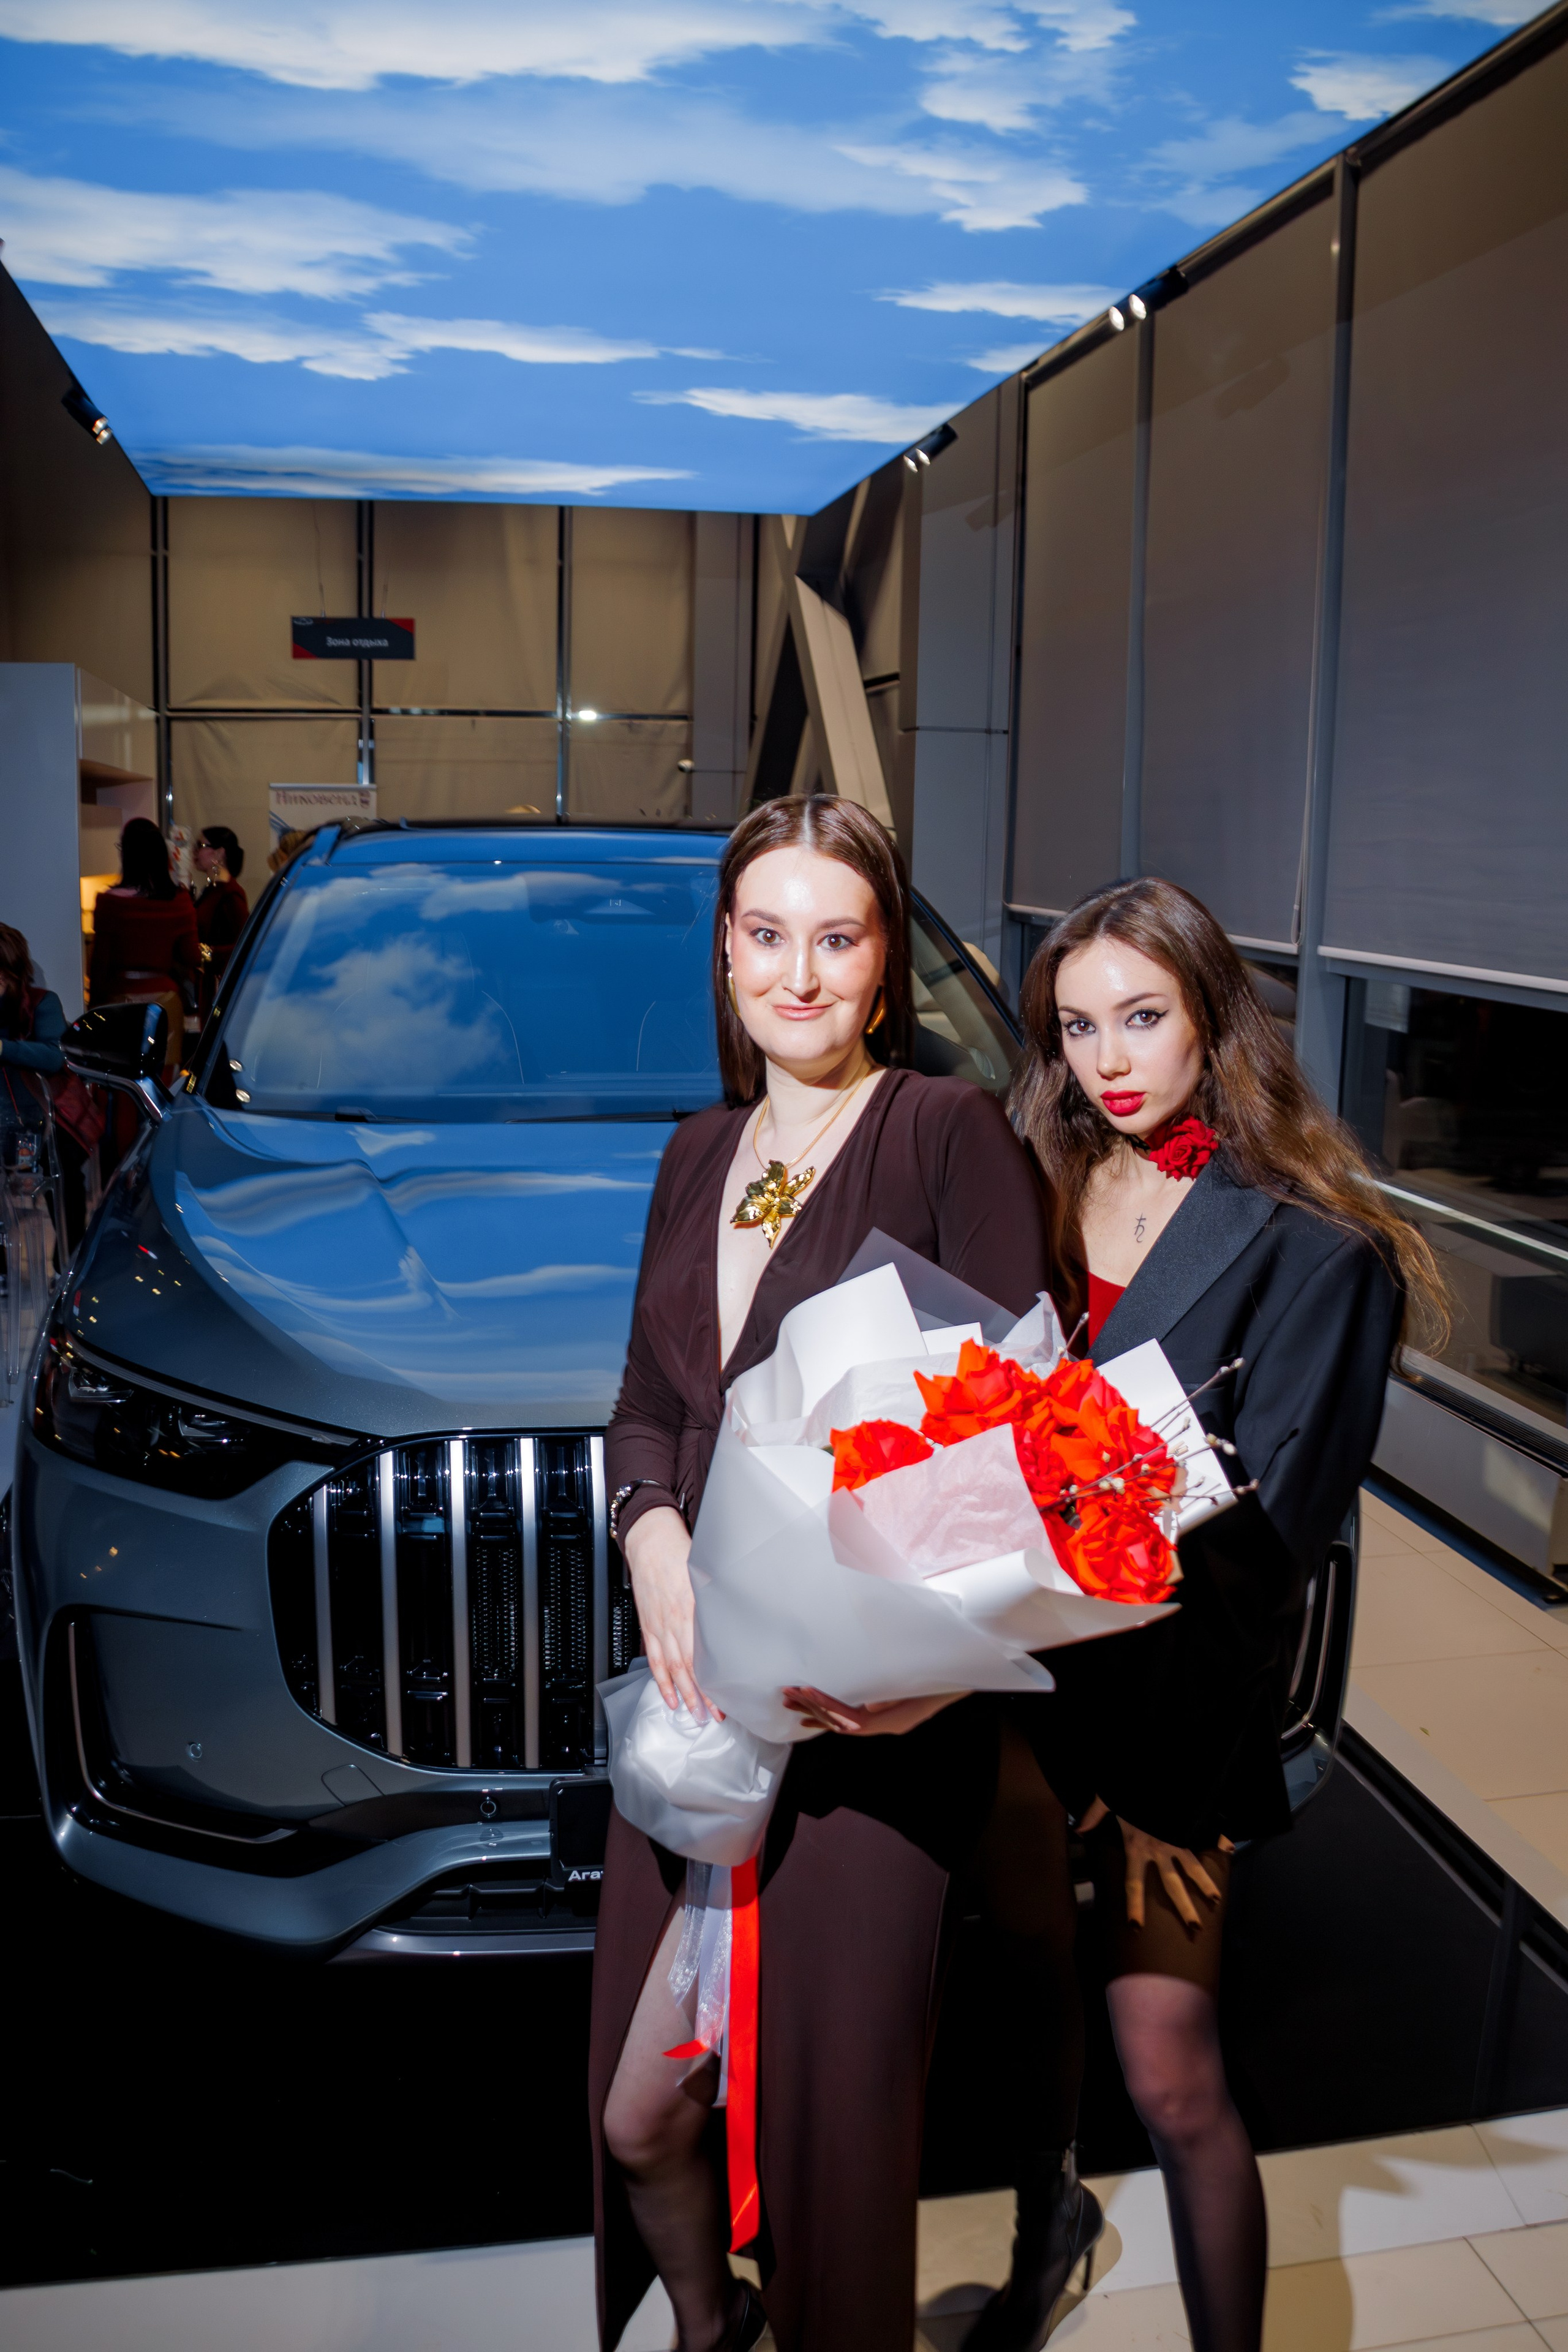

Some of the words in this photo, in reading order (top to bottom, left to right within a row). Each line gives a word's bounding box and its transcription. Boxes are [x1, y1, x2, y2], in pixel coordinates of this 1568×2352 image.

[326, 636, 350, 647] Зона
[352, 638, 389, 647] отдыха
[568, 1870, 603, 1881] Ага
